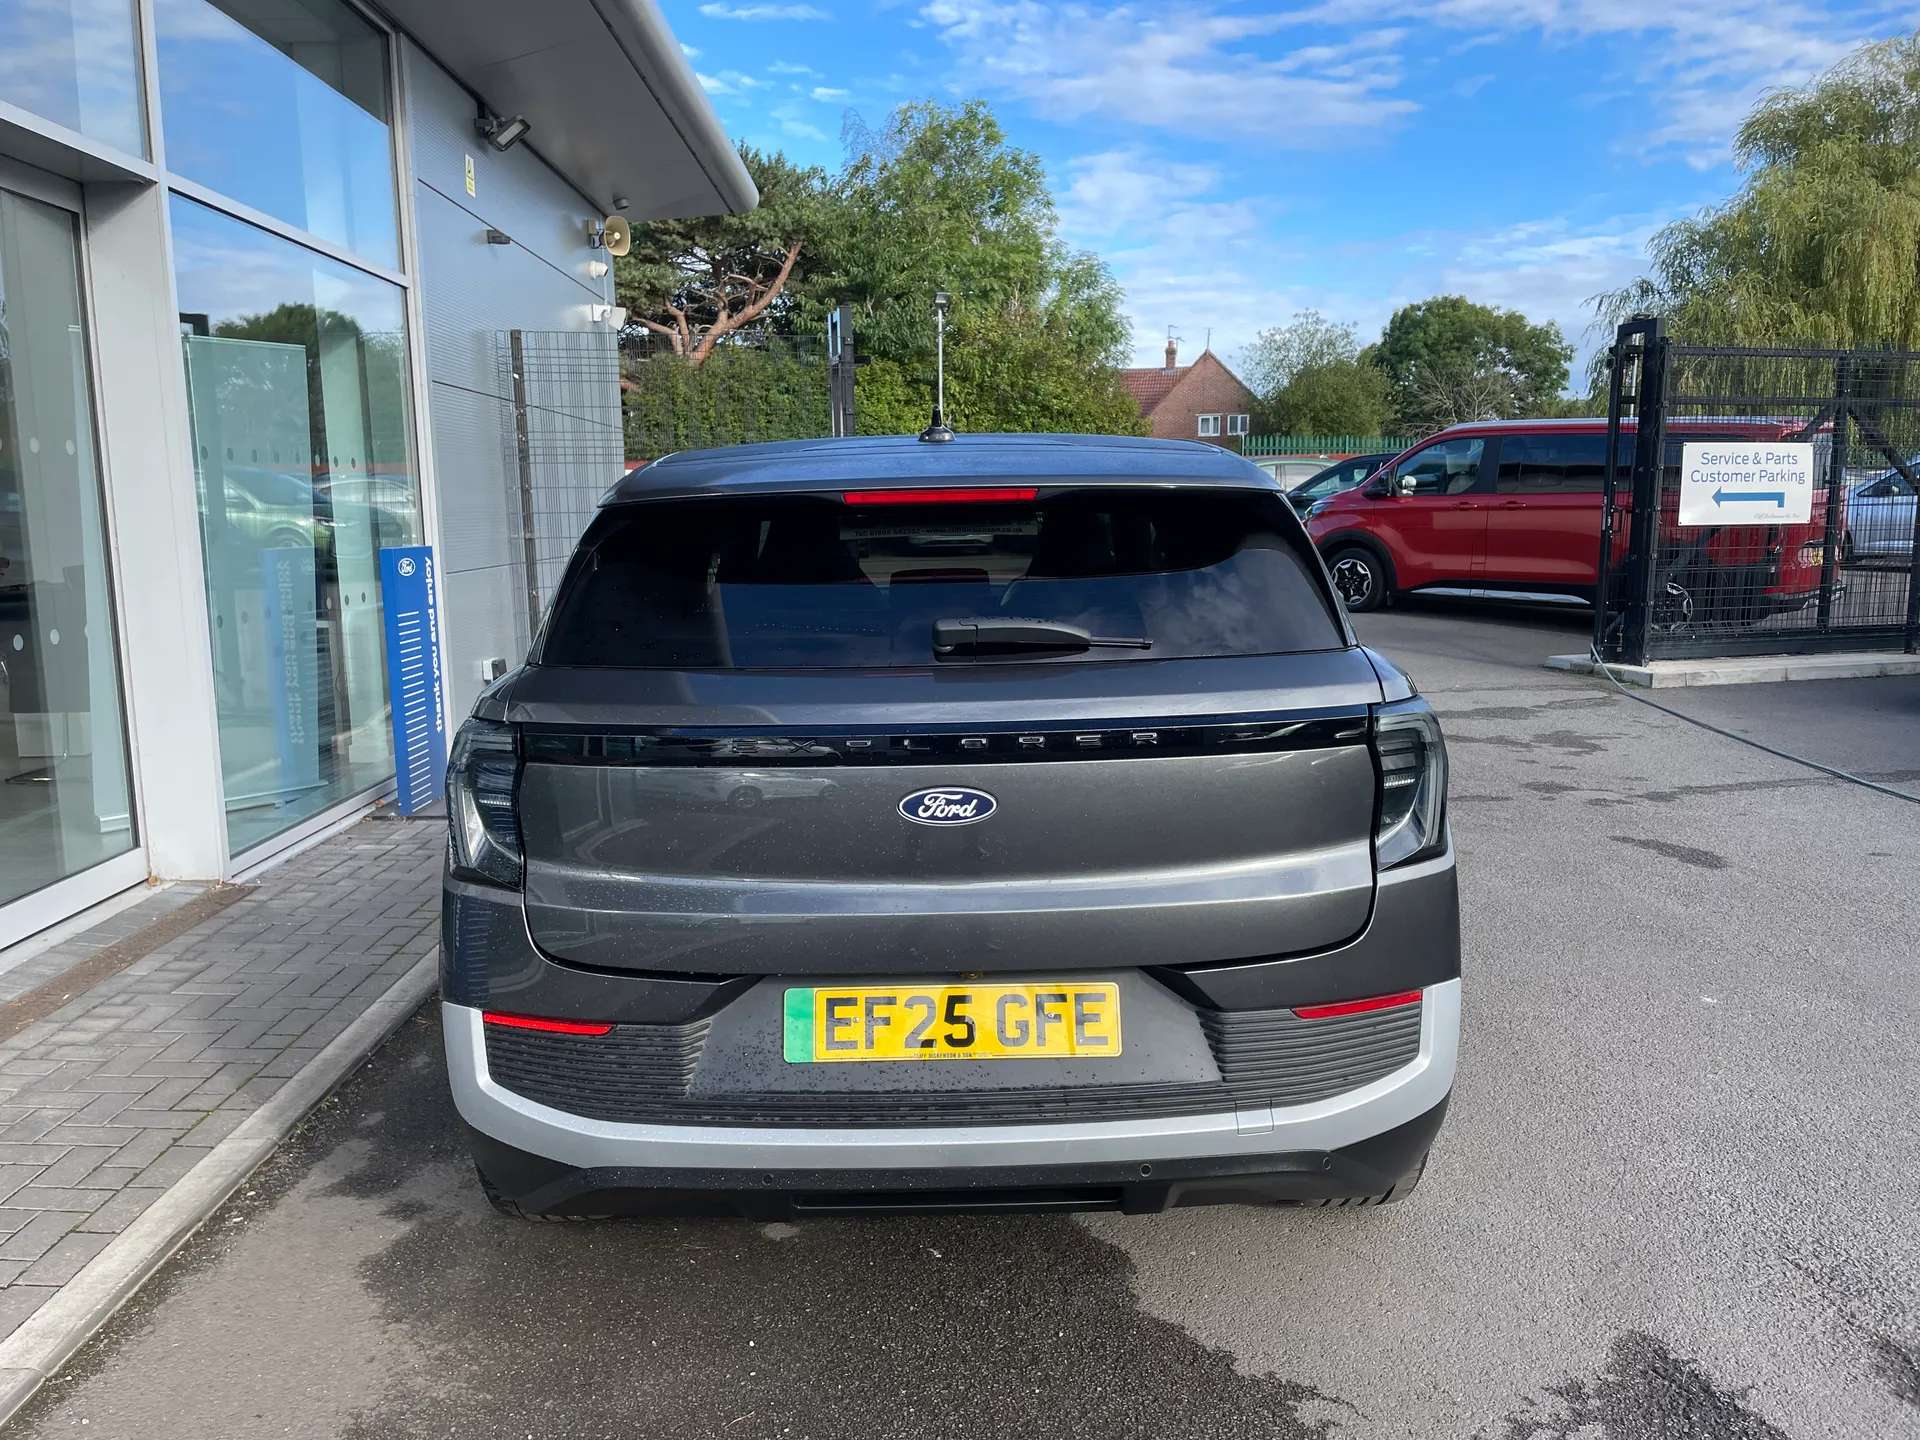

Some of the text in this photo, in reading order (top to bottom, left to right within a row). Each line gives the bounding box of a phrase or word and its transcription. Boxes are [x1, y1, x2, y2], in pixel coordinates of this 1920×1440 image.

[1700, 452, 1798, 465] Service & Parts
[1690, 469, 1806, 484] Customer Parking
[424, 556, 443, 733] thank you and enjoy
[918, 793, 978, 818] Ford
[825, 992, 1109, 1050] EF25 GFE
